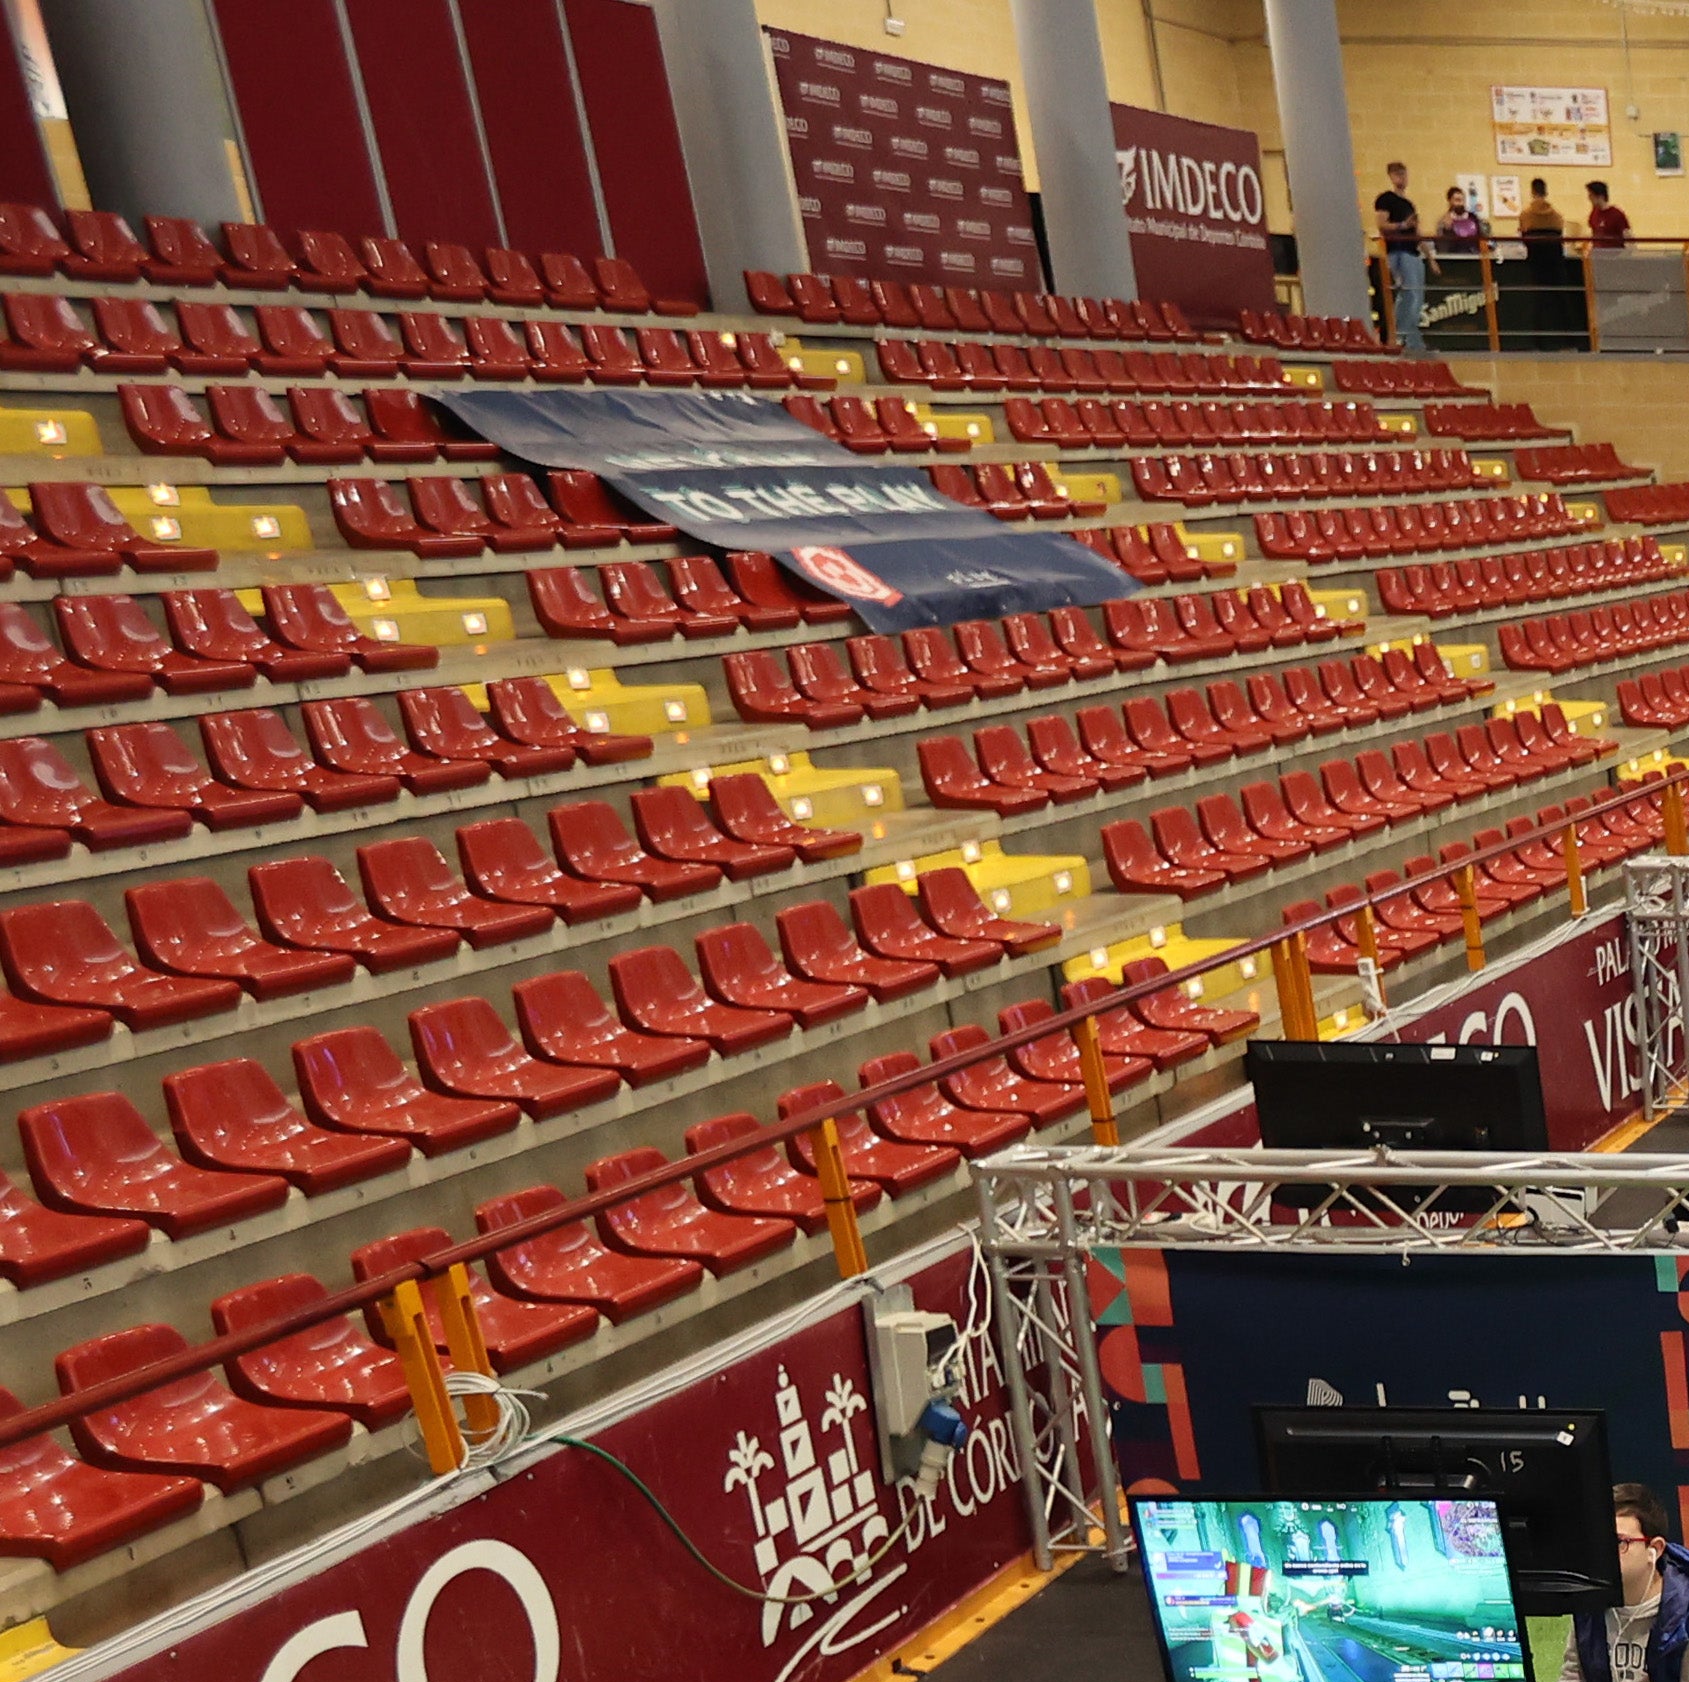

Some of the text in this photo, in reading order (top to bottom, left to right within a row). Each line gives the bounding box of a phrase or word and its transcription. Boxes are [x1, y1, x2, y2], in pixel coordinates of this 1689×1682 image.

[1139, 148, 1263, 225] IMDECO
[1418, 282, 1499, 329] SanMigul
[640, 485, 751, 523] TO
[1500, 1451, 1524, 1473] 15
